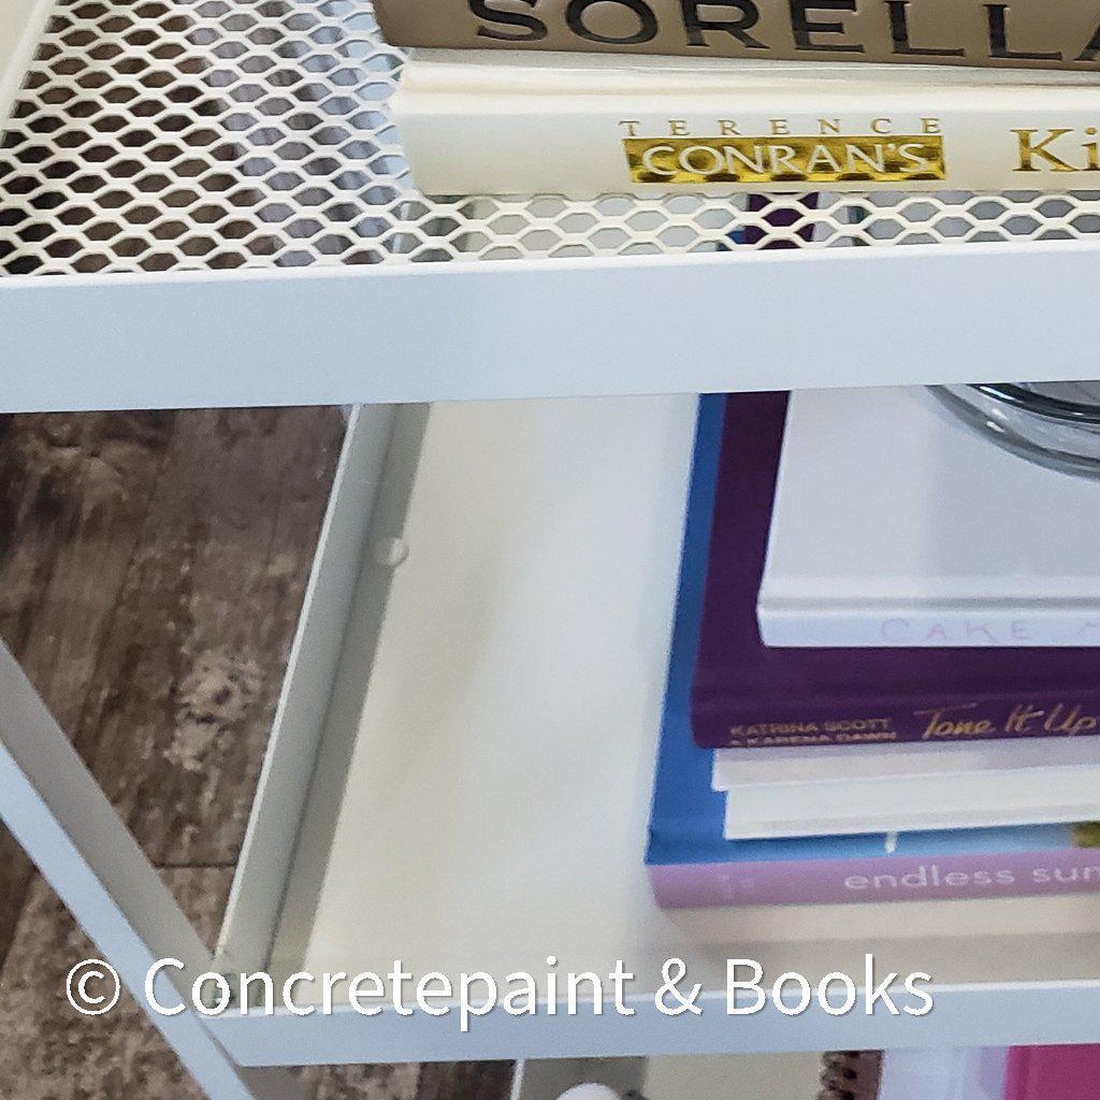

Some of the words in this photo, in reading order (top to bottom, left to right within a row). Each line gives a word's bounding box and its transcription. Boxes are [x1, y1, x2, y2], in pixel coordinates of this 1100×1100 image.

[618, 117, 943, 137] TERENCE
[643, 143, 929, 176] CONRAN'S
[879, 618, 1031, 643] CAKE
[913, 702, 996, 740] Tone
[1044, 703, 1097, 736] Up
[844, 865, 1016, 890] endless
